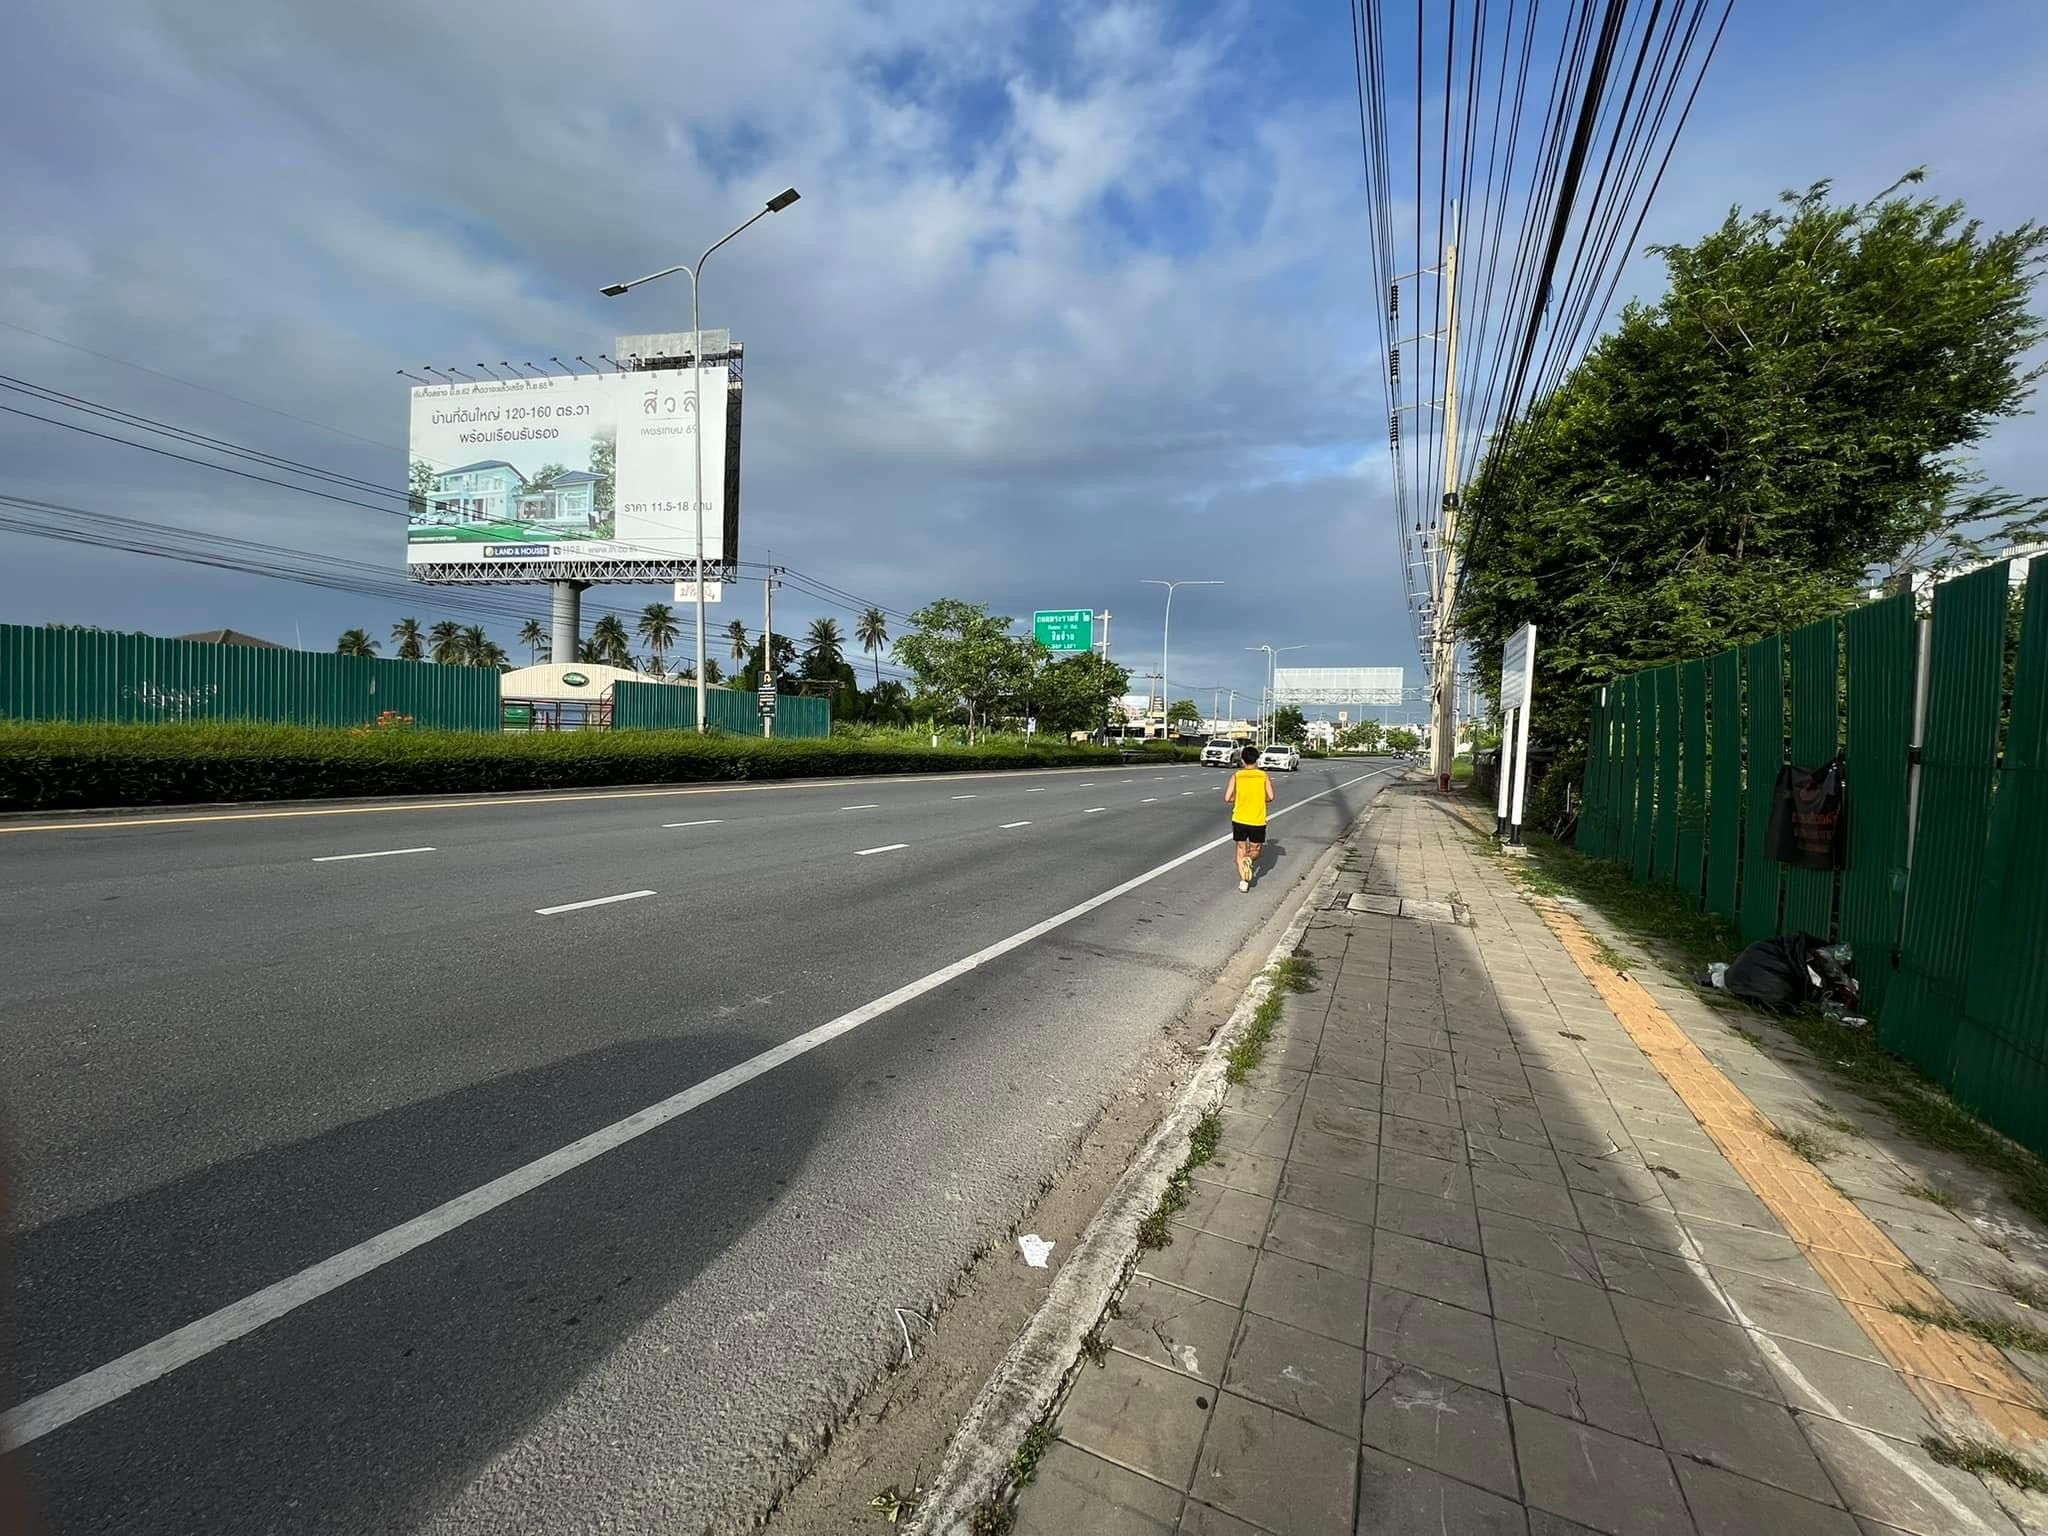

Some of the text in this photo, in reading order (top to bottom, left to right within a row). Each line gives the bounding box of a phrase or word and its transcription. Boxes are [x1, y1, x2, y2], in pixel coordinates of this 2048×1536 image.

[432, 404, 590, 425] บ้านที่ดินใหญ่ 120-160 ตร.วา
[459, 426, 559, 444] พร้อมเรือนรับรอง
[624, 503, 647, 513] ราคา
[651, 501, 689, 512] 11.5-18
[495, 546, 514, 556] LAND
[521, 545, 547, 556] HOUSES
